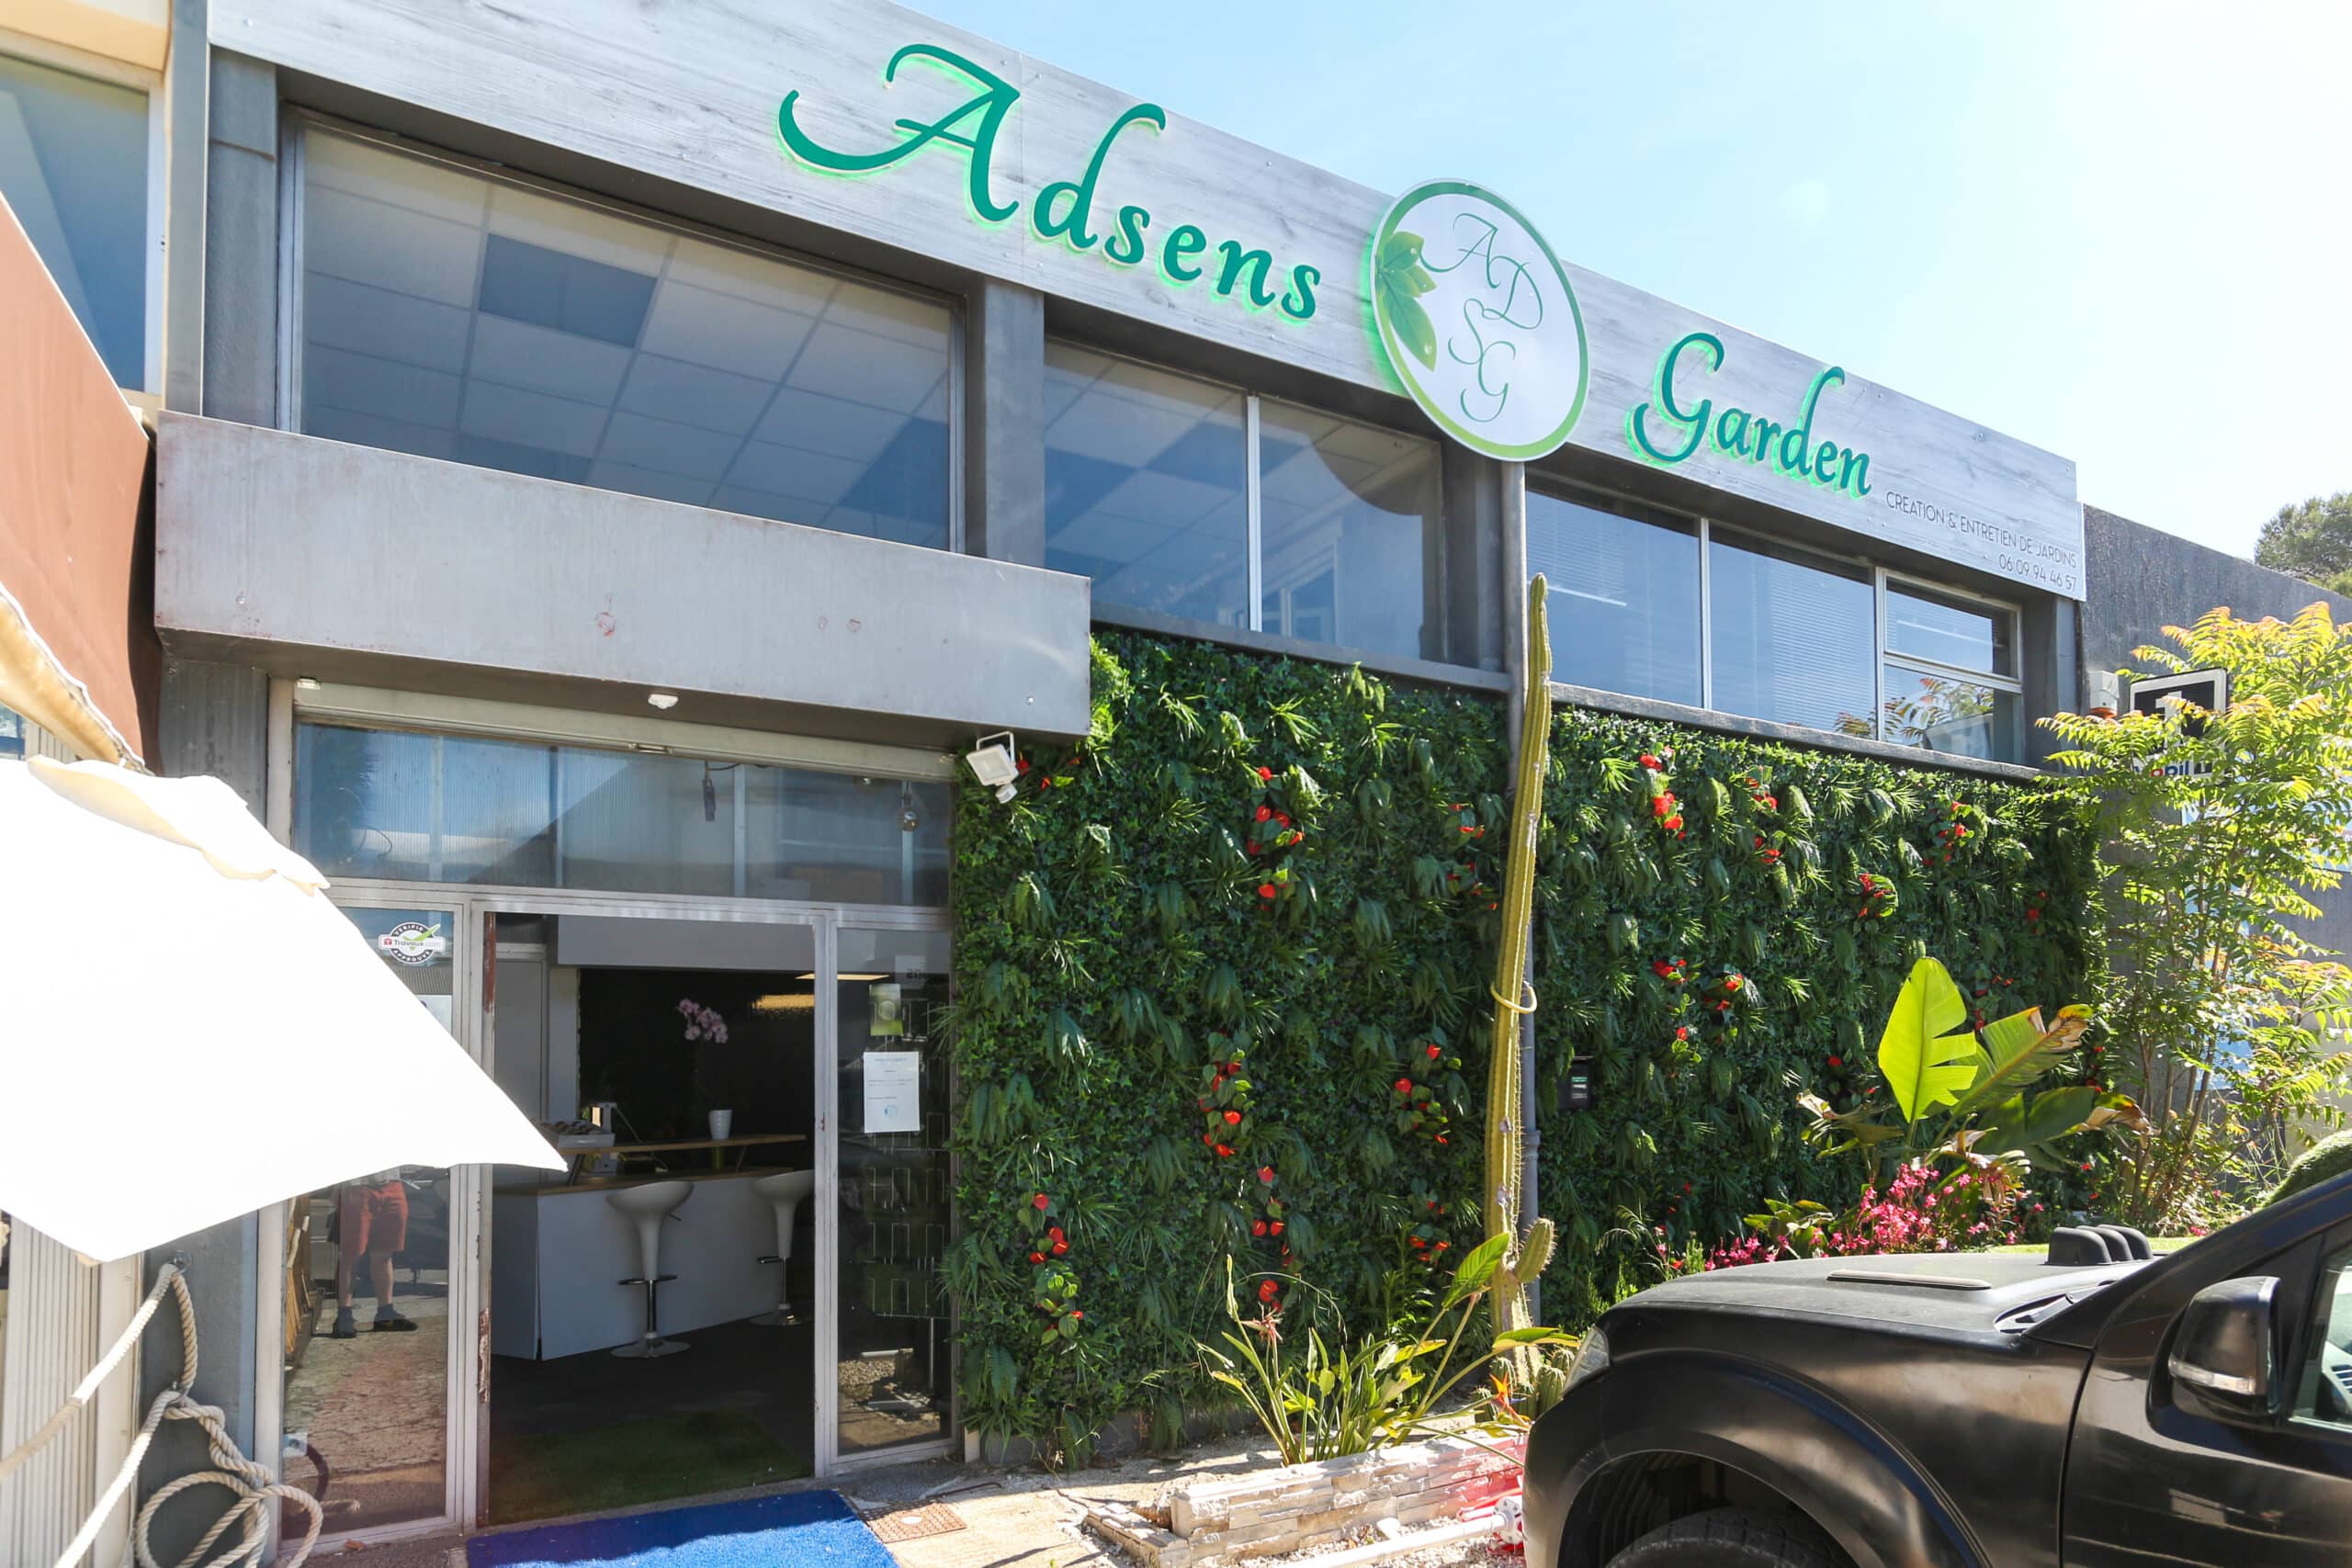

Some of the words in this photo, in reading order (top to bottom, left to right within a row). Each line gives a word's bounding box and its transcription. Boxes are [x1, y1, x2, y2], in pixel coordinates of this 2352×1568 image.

[777, 43, 1321, 321] Adsens
[1630, 332, 1872, 497] Garden
[1885, 491, 1945, 524] CREATION
[1948, 513, 1956, 529] &
[1961, 516, 2017, 547] ENTRETIEN
[2019, 536, 2033, 554] DE
[2036, 541, 2077, 569] JARDINS
[1998, 553, 2013, 571] 06
[2017, 558, 2030, 576] 09
[2033, 562, 2046, 581] 94
[2050, 568, 2064, 587] 46
[2065, 574, 2077, 592] 57
